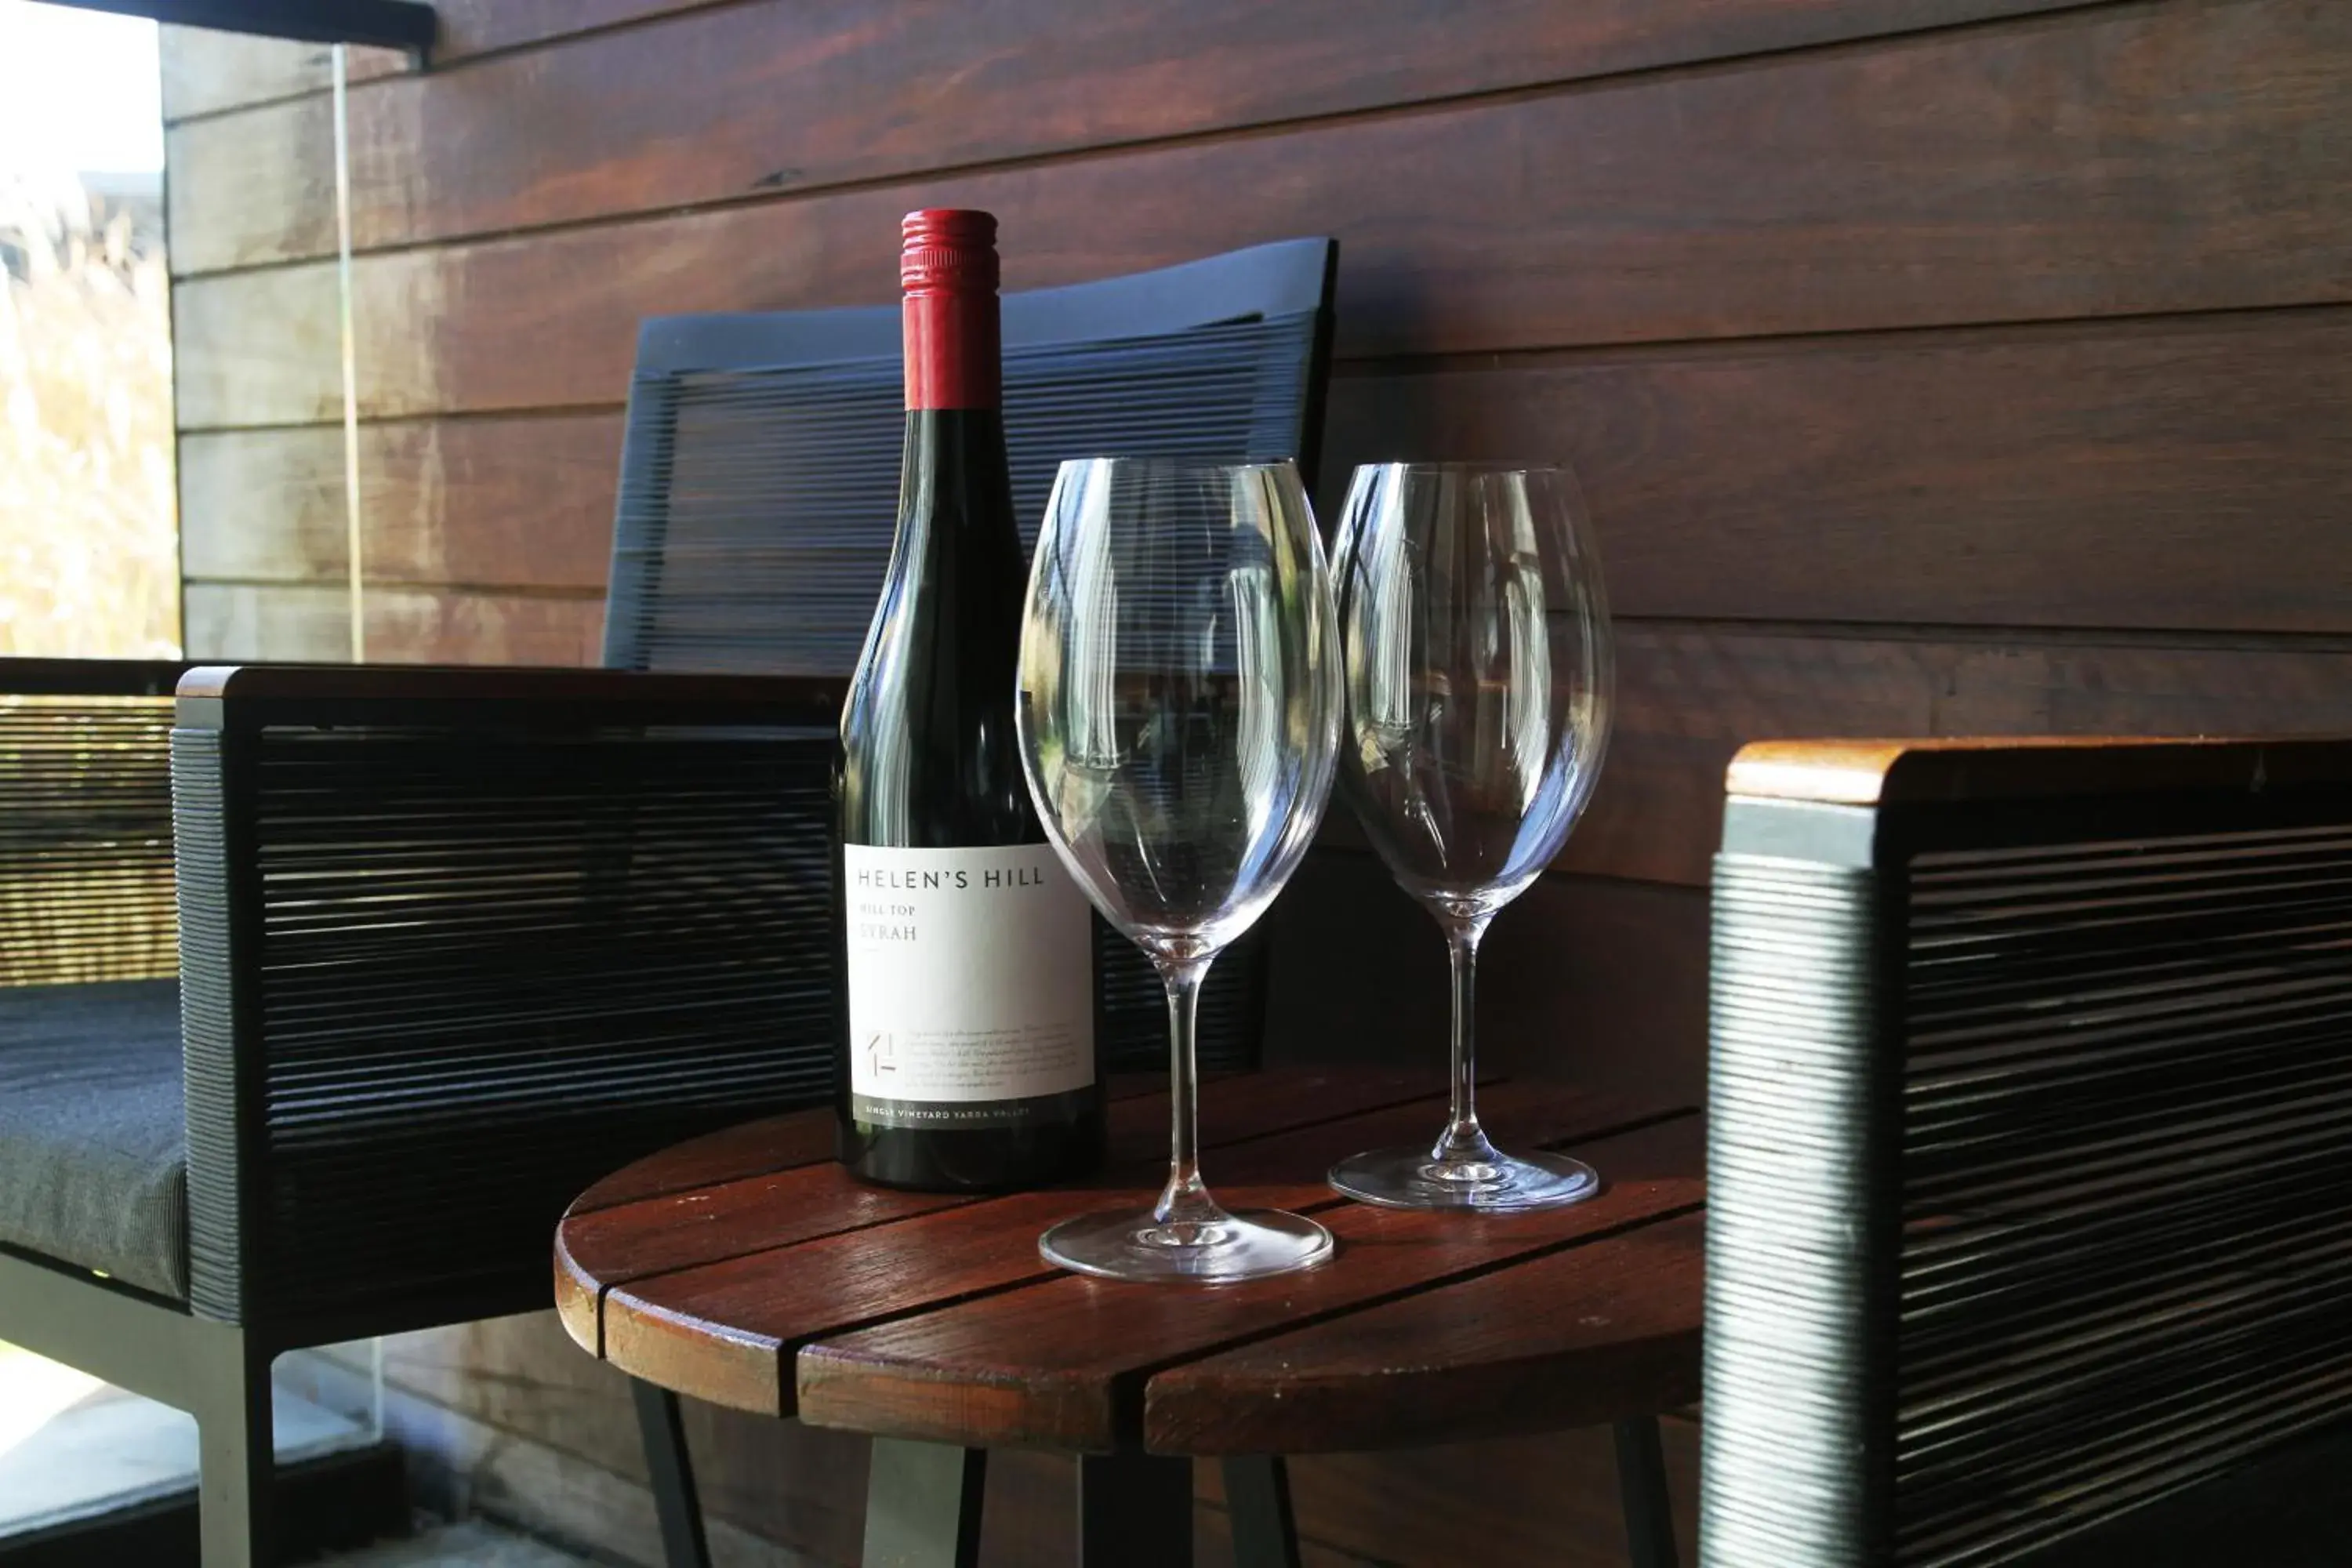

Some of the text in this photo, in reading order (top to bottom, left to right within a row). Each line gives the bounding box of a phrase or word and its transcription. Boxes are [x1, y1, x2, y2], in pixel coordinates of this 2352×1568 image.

[858, 866, 1044, 889] HELEN'S HILL
[890, 904, 916, 916] TOP
[898, 1109, 949, 1120] VINEYARD
